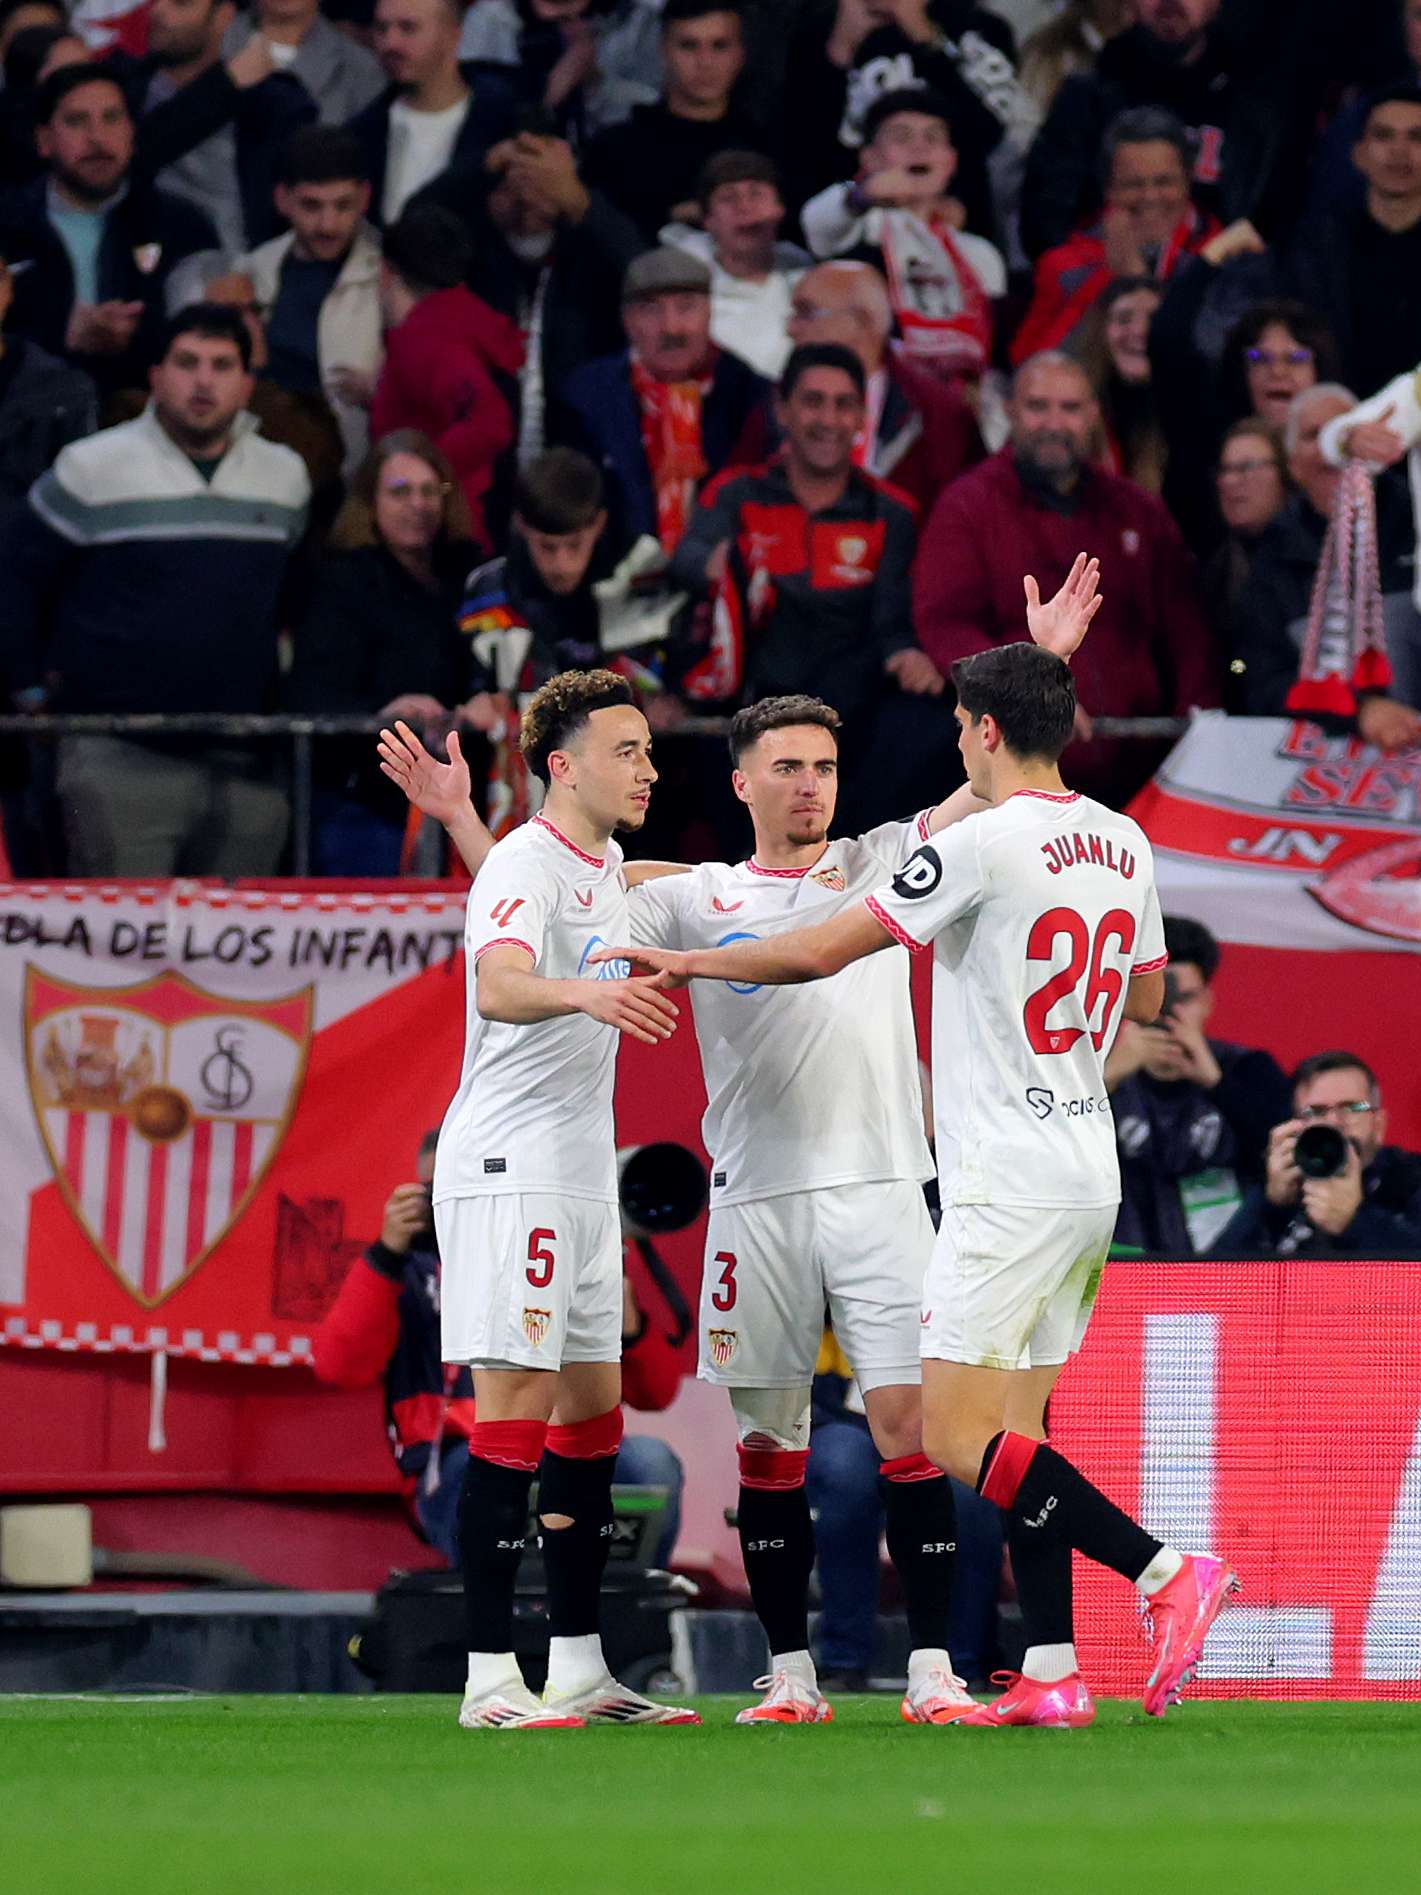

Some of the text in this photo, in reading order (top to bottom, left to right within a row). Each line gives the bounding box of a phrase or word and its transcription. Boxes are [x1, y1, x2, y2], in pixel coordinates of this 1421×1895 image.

[1041, 833, 1136, 880] JUANLU
[110, 921, 167, 960] DE
[182, 925, 273, 968] LOS
[1023, 906, 1136, 1055] 26
[525, 1227, 557, 1288] 5
[711, 1251, 738, 1312] 3
[748, 1539, 785, 1551] SFC
[922, 1542, 957, 1554] SFC
